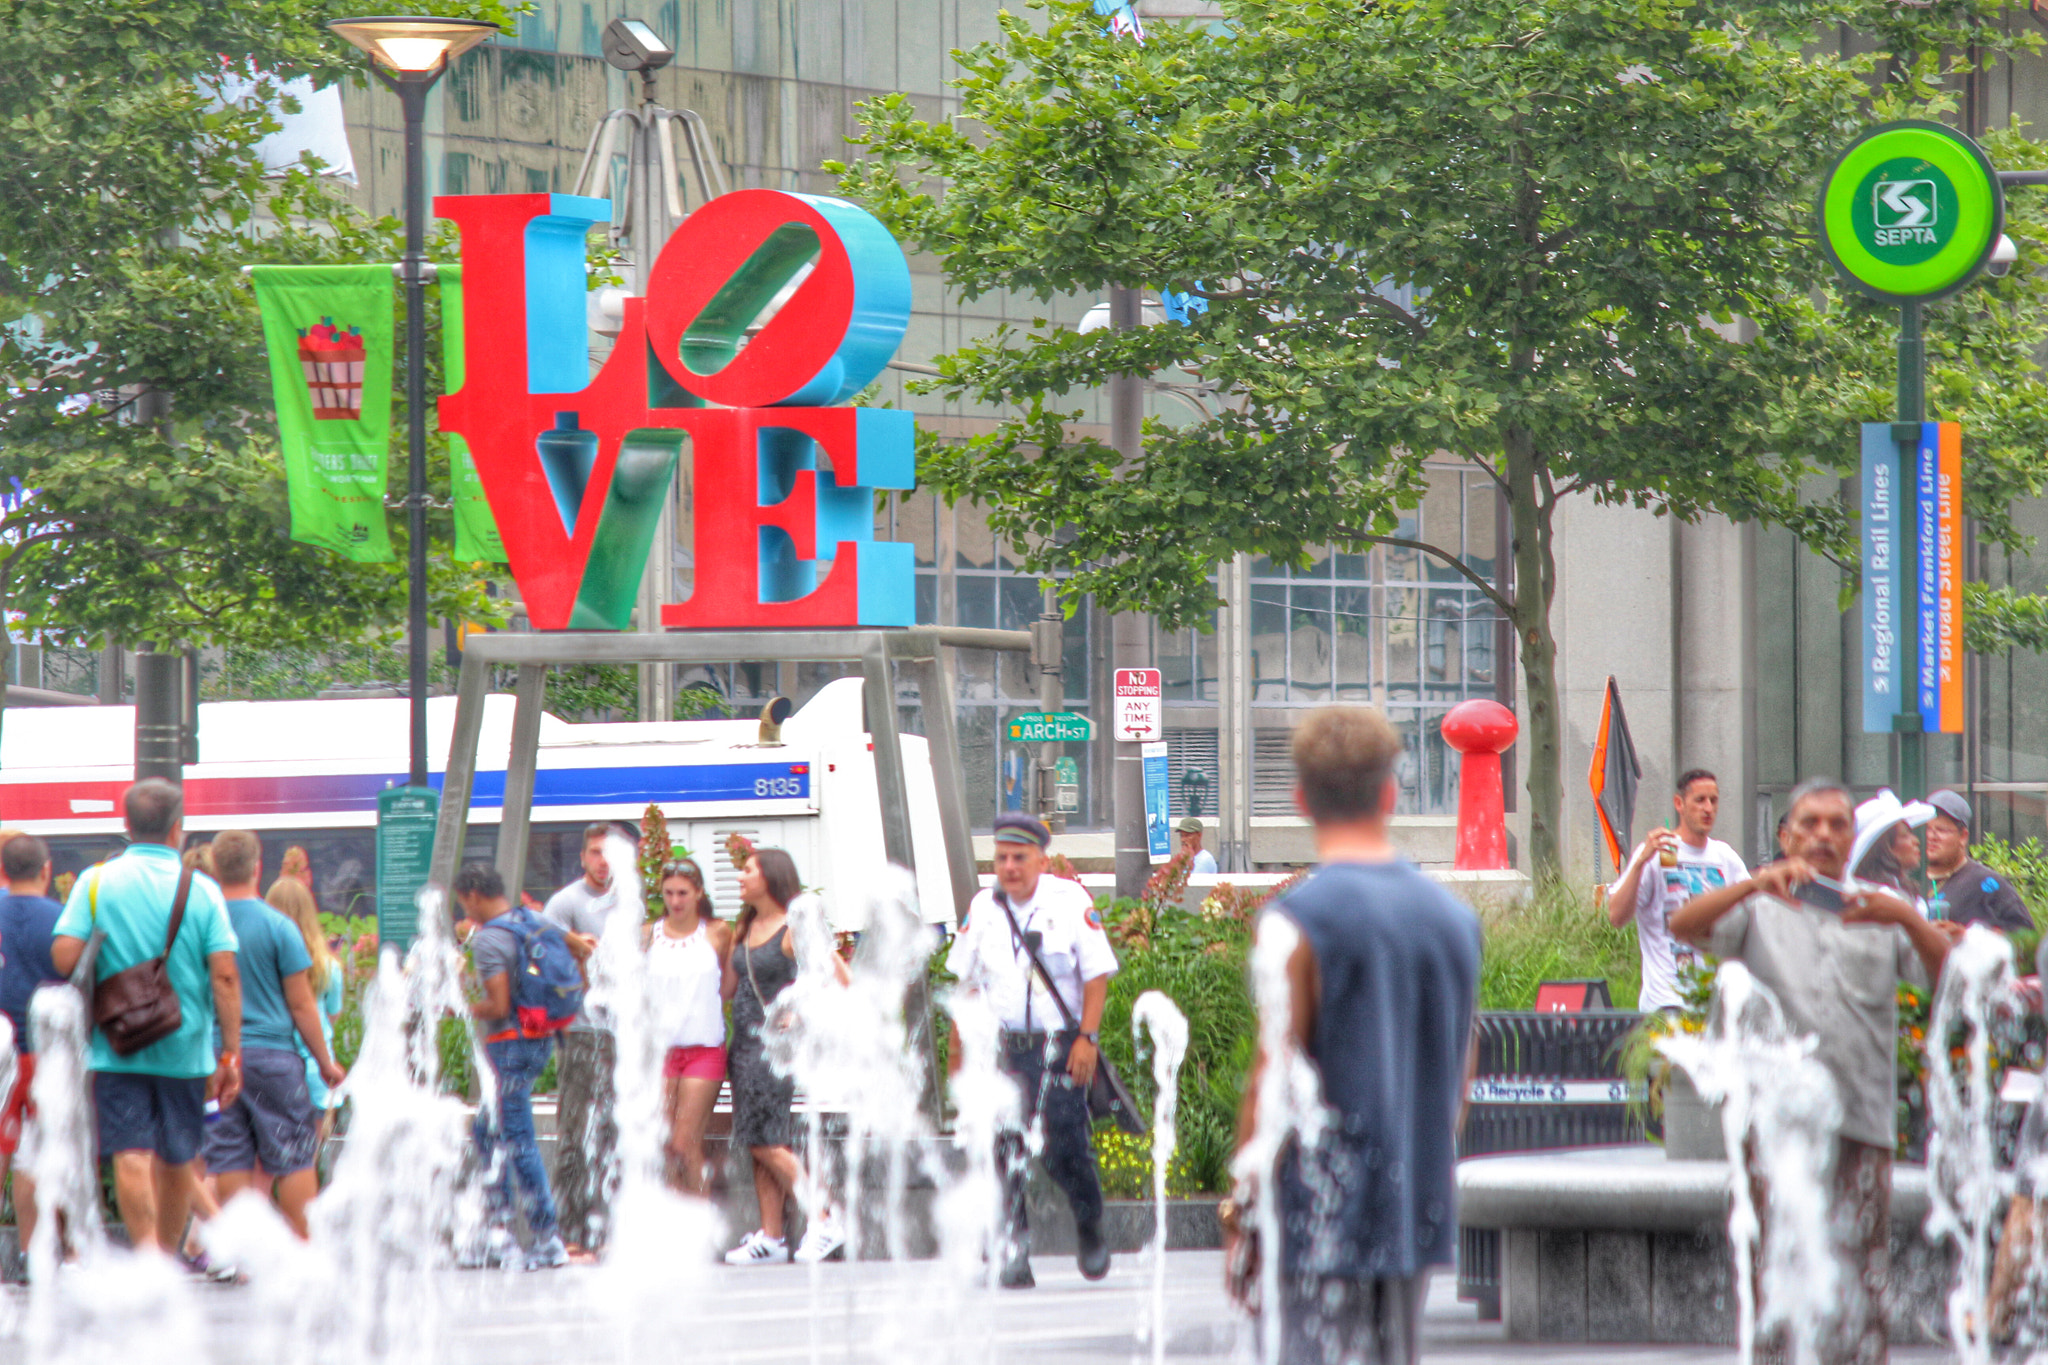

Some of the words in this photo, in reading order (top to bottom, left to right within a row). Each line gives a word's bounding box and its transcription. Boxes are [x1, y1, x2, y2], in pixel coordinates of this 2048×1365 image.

[1873, 228, 1938, 246] SEPTA
[1920, 447, 1934, 494] Line
[1869, 462, 1890, 521] Lines
[1938, 473, 1952, 518] Line
[1870, 526, 1890, 571] Rail
[1920, 500, 1935, 605] Frankford
[1870, 575, 1894, 673] Regional
[1921, 608, 1935, 688] Market
[1128, 671, 1147, 686] NO
[1117, 685, 1159, 696] STOPPING
[1125, 702, 1151, 711] ANY
[1124, 713, 1153, 722] TIME
[1022, 722, 1067, 740] ARCH
[1072, 727, 1086, 738] ST
[754, 778, 801, 797] 8135
[1489, 1083, 1545, 1103] Recycle
